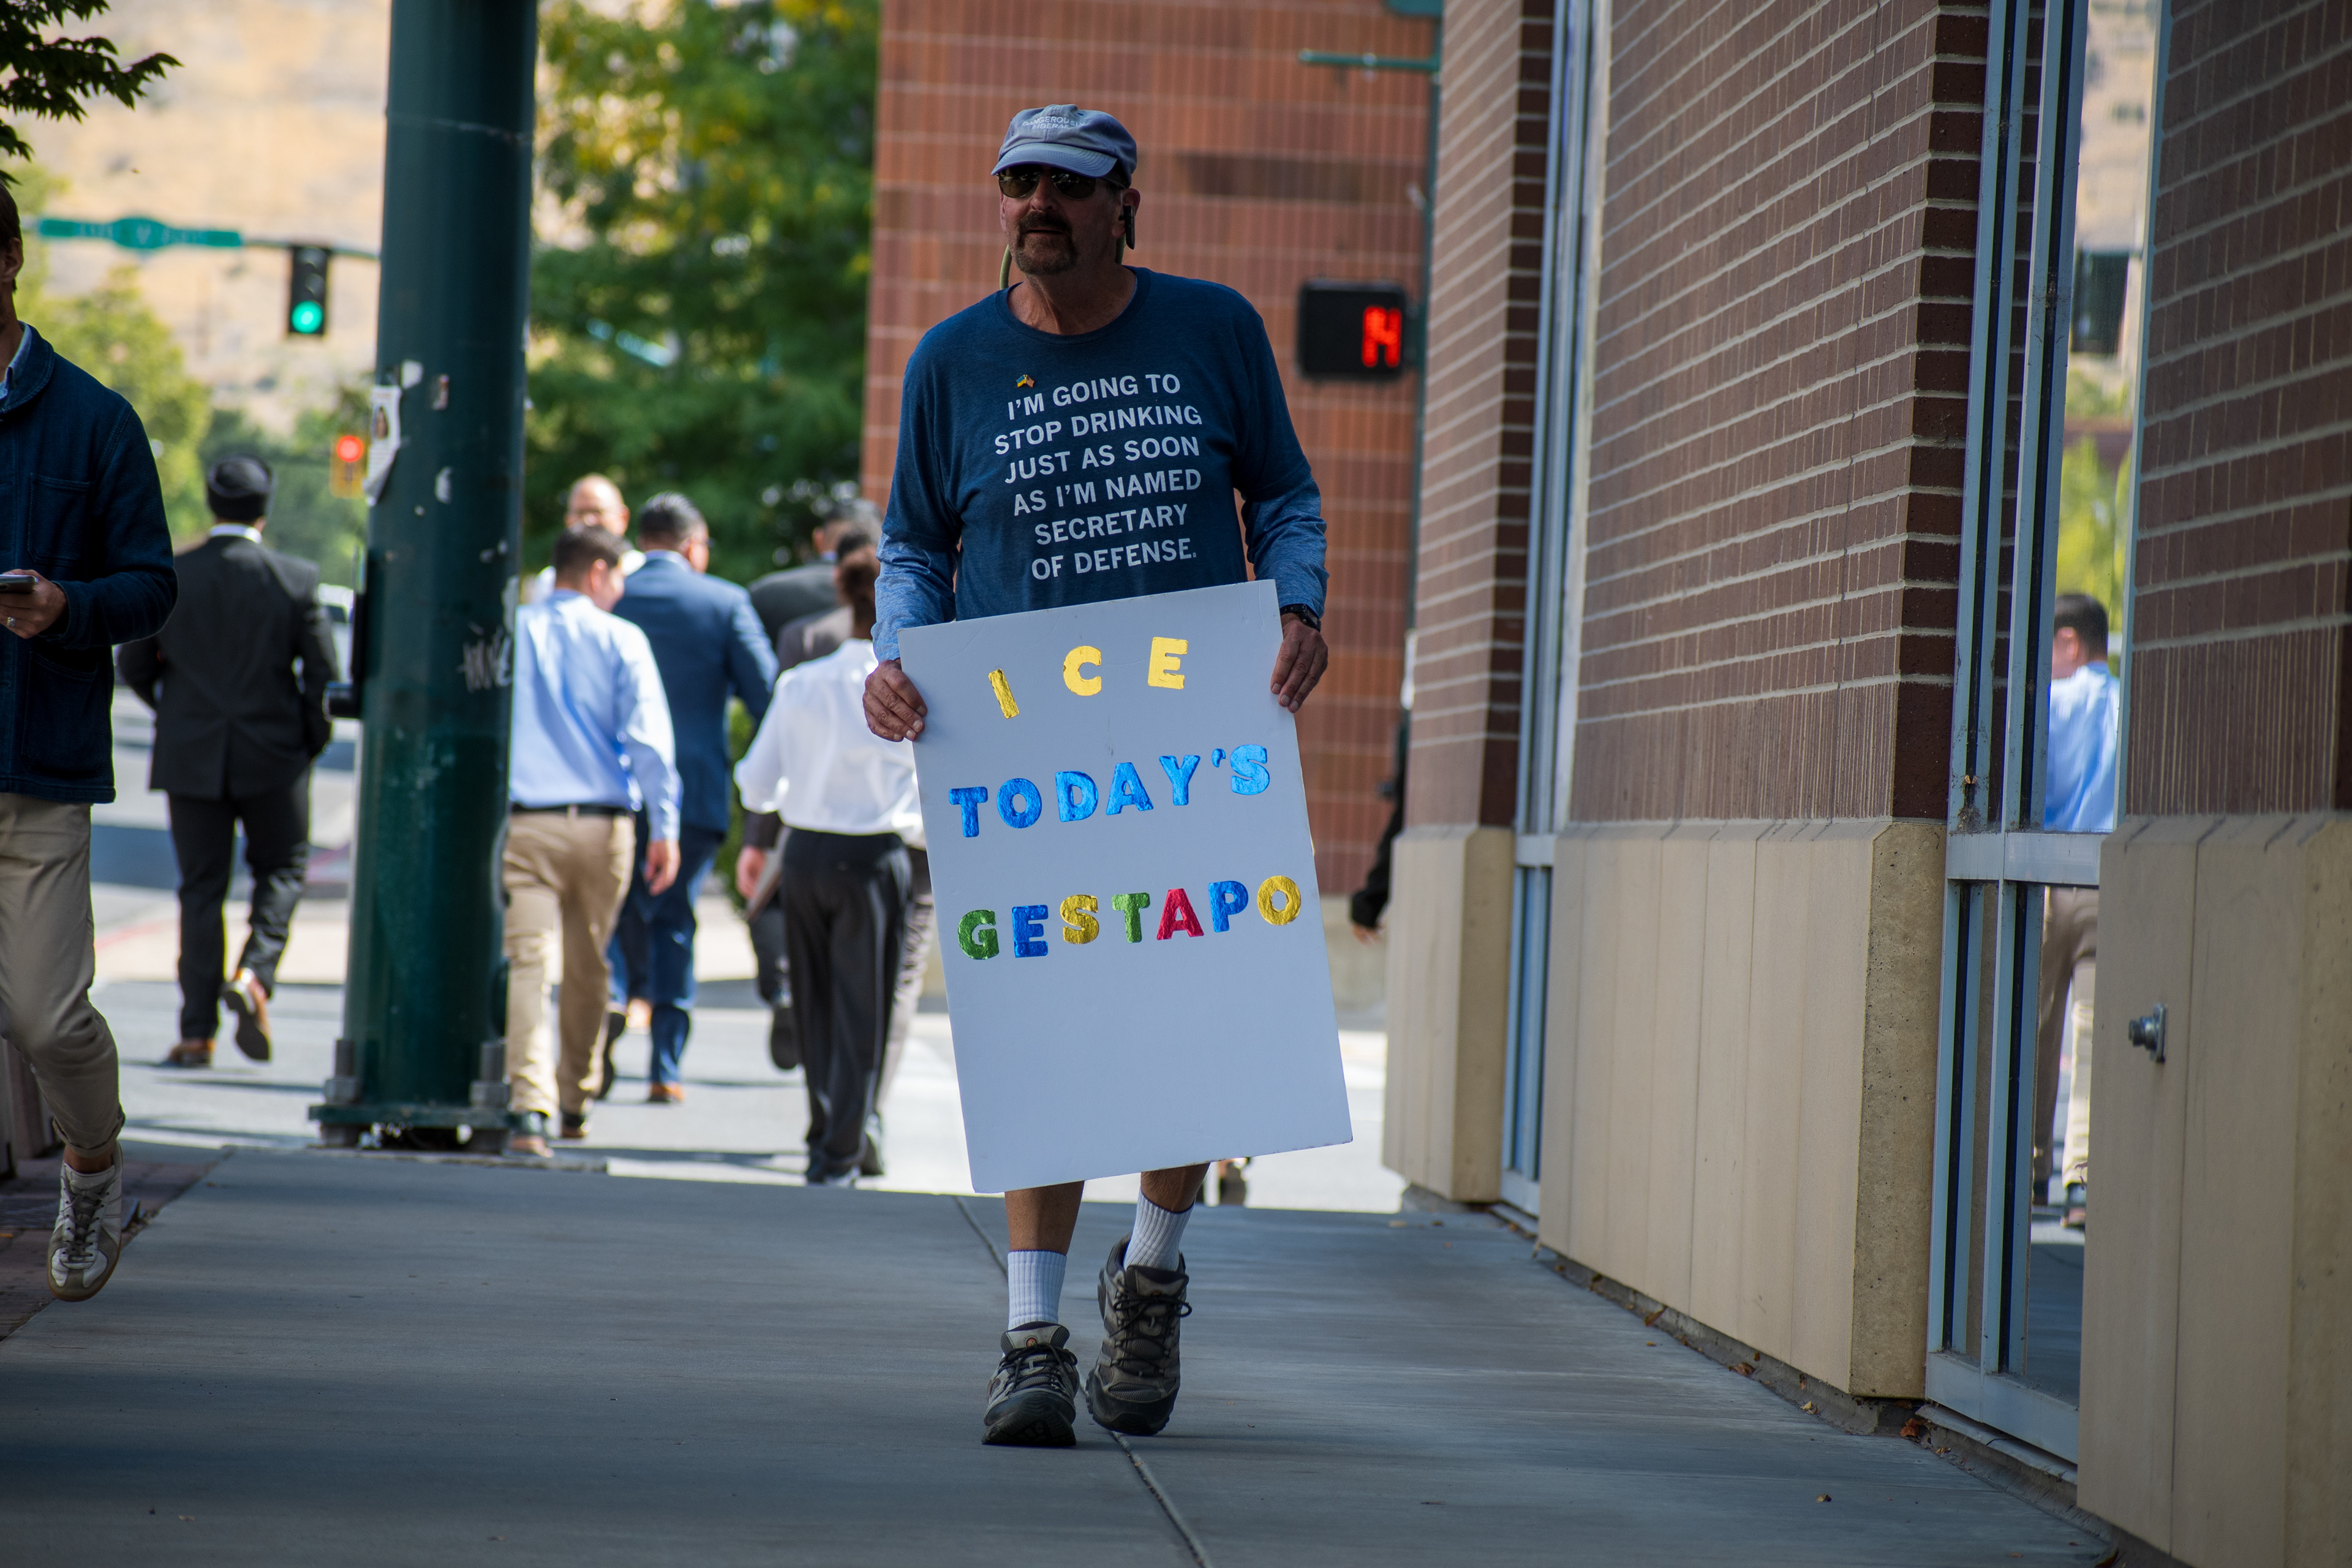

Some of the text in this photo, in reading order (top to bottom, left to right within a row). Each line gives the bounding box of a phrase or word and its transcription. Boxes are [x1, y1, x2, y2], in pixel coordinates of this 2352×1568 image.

[1008, 374, 1180, 420] I'M GOING TO
[994, 405, 1202, 454] STOP DRINKING
[1005, 436, 1199, 484] JUST AS SOON
[1014, 469, 1201, 516] AS I'M NAMED
[1035, 503, 1188, 545] SECRETARY
[1031, 538, 1196, 579] OF DEFENSE.
[988, 636, 1188, 718] ICE
[949, 744, 1270, 837] TODAY'S
[957, 875, 1301, 960] GESTAPO
